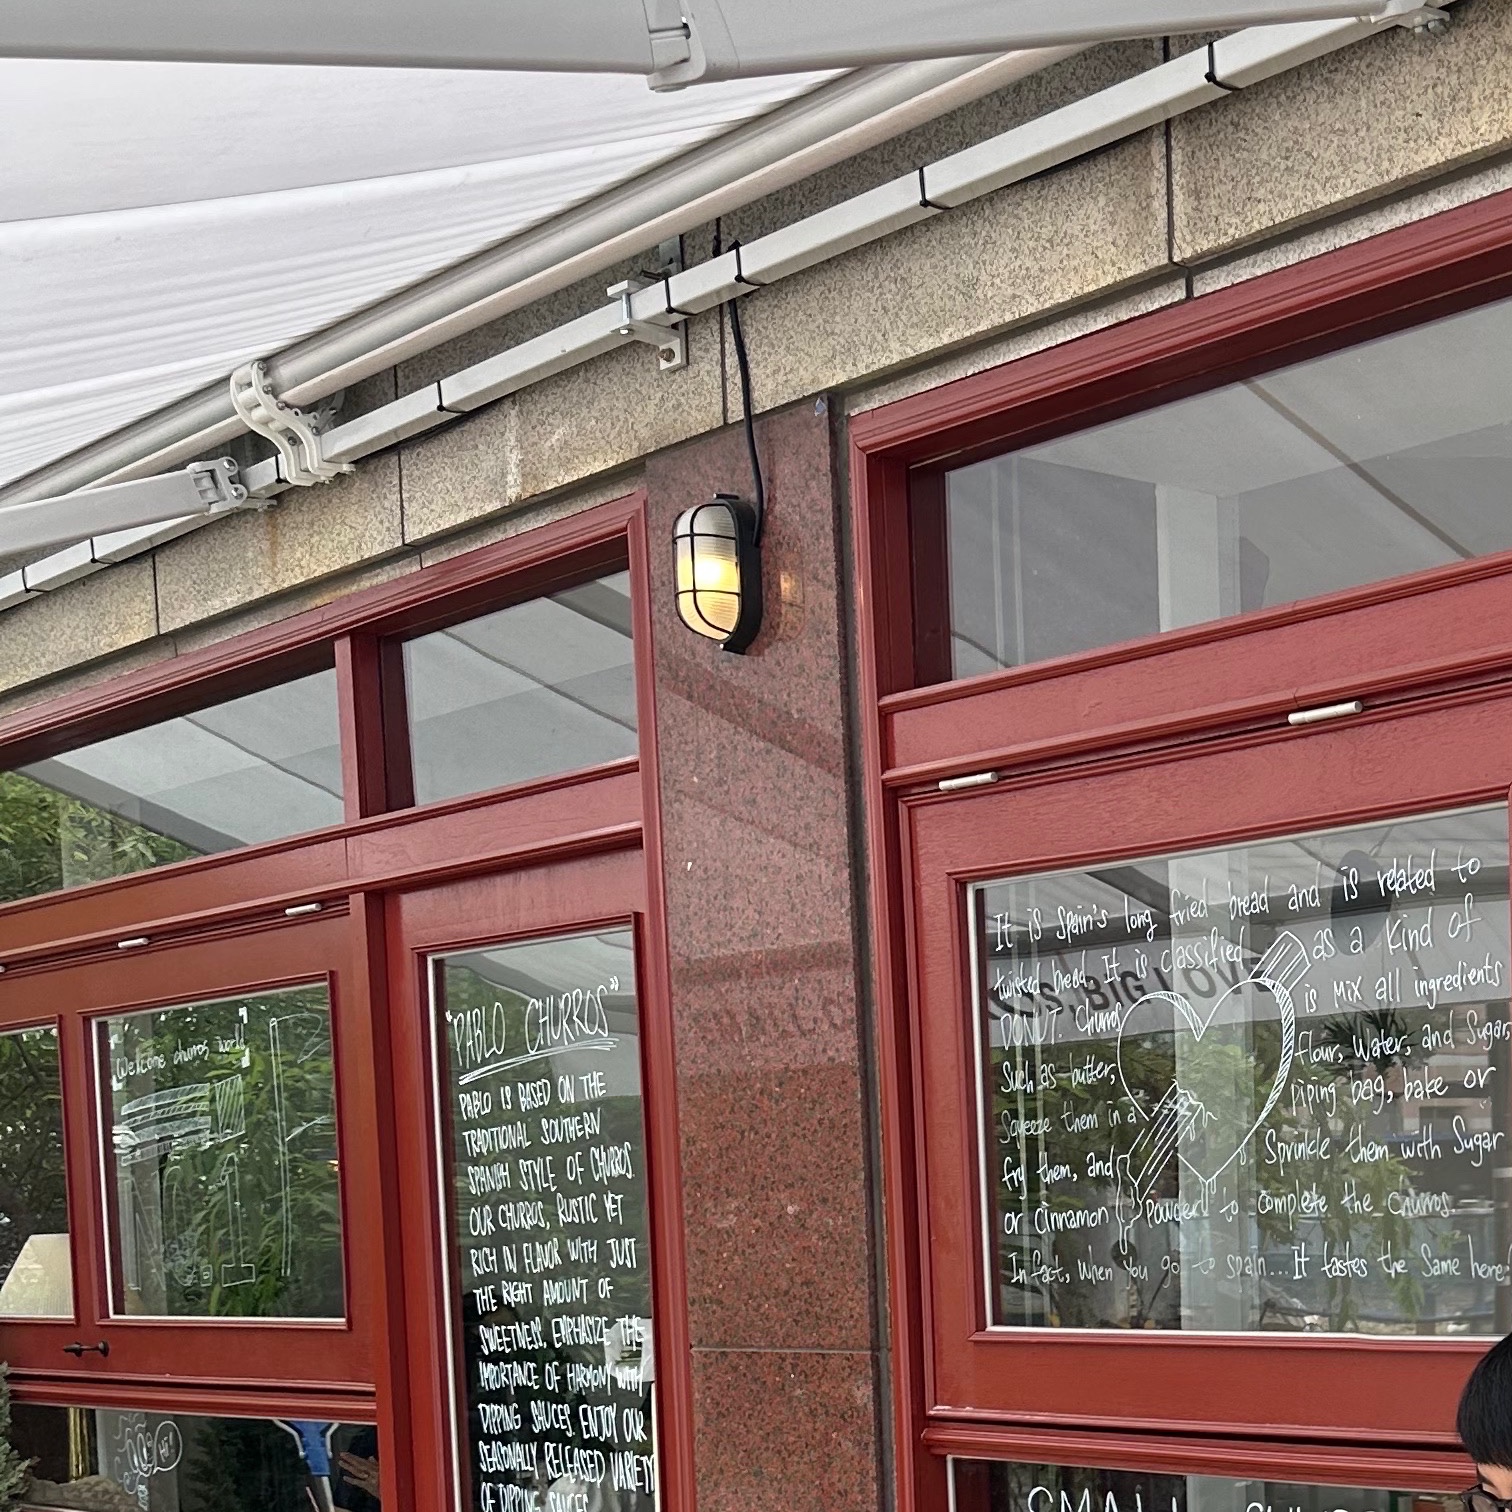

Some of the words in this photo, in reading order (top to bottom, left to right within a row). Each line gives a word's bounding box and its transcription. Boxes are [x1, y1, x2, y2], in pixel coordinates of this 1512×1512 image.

[993, 912, 1014, 951] It
[1124, 894, 1158, 942] long
[1169, 878, 1208, 927] fried
[1227, 875, 1269, 920] bread
[1288, 861, 1322, 911] and
[1378, 848, 1436, 898] related
[1450, 846, 1481, 883] to
[993, 962, 1041, 1002] twisted
[1102, 947, 1121, 984] It
[1161, 925, 1245, 973] classified
[1312, 927, 1335, 961] as
[1350, 926, 1365, 954] a
[1448, 893, 1482, 943] of
[1375, 967, 1400, 1002] all
[1414, 952, 1503, 1010] ingredients
[1421, 1010, 1455, 1051] and
[459, 1090, 492, 1122] PABLO
[500, 1086, 512, 1110] IS
[517, 1078, 550, 1113] BASED
[558, 1074, 575, 1104] ON
[578, 1071, 607, 1100] THE
[1061, 1099, 1099, 1133] them
[1106, 1100, 1121, 1128] in
[1127, 1106, 1137, 1124] a
[1290, 1077, 1337, 1117] piping
[1350, 1069, 1393, 1115] bag,
[1403, 1065, 1449, 1101] bake
[1463, 1066, 1497, 1090] or
[462, 1120, 532, 1158] TRADITIONAL
[540, 1107, 601, 1145] SOUTHERN
[467, 1162, 511, 1197] SPANISH
[518, 1156, 558, 1192] STYLE
[566, 1151, 585, 1185] OF
[1001, 1156, 1028, 1200] fry
[1036, 1152, 1078, 1185] them,
[1086, 1144, 1114, 1178] and
[1345, 1123, 1389, 1163] them
[1400, 1123, 1442, 1162] with
[469, 1204, 496, 1237] OUR
[556, 1192, 599, 1227] RUSTIC
[603, 1190, 624, 1225] YET
[1004, 1211, 1021, 1235] or
[1219, 1186, 1239, 1223] to
[1340, 1180, 1373, 1213] the
[469, 1246, 499, 1278] RICH
[502, 1243, 517, 1274] IN
[523, 1237, 562, 1275] FLAVOR
[567, 1235, 598, 1264] WITH
[606, 1237, 637, 1269] JUST
[1161, 1256, 1180, 1289] go
[1321, 1241, 1368, 1279] tastes
[1377, 1240, 1408, 1279] the
[472, 1284, 498, 1315] THE
[501, 1280, 533, 1308] RIGHT
[543, 1276, 589, 1306] AMOUNT
[598, 1277, 614, 1299] OF
[551, 1314, 611, 1349] EMPHASIZE
[615, 1314, 645, 1351] THE
[479, 1360, 540, 1395] IMPORTANCE
[545, 1361, 560, 1393] OF
[566, 1362, 612, 1396] HARMONY
[478, 1403, 521, 1435] DIPPING
[579, 1402, 618, 1444] ENJOY
[623, 1407, 647, 1443] OUR
[478, 1441, 539, 1480] SEASONALLY
[544, 1441, 606, 1488] RELEASED
